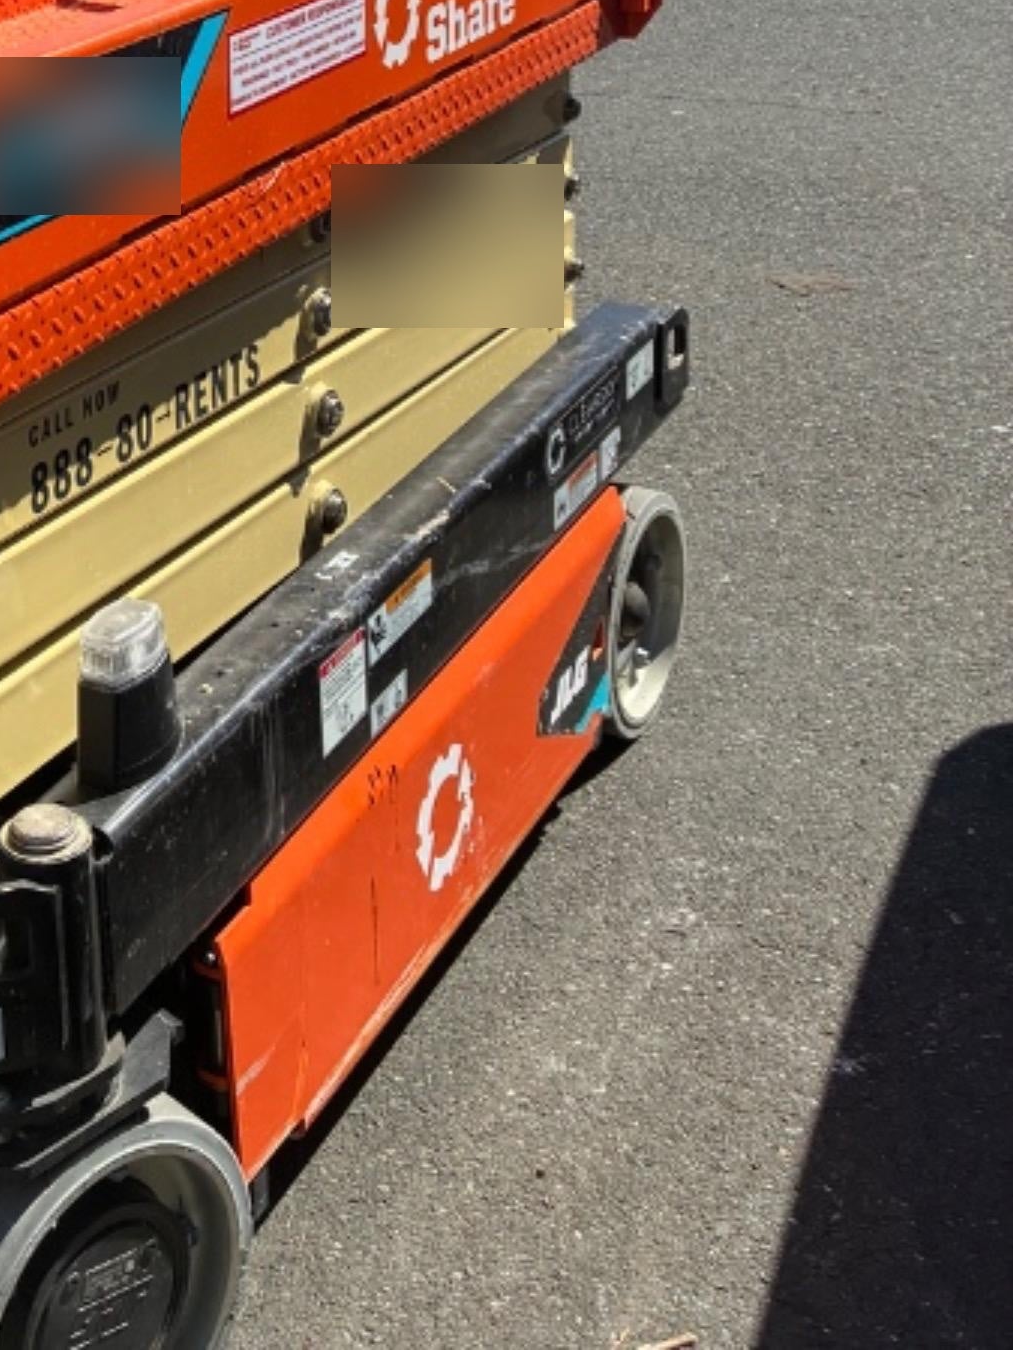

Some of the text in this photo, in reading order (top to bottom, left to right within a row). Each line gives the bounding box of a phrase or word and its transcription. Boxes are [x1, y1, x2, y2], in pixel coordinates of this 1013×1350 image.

[28, 381, 121, 447] CALL NOW
[31, 344, 261, 514] 888-80-RENTS
